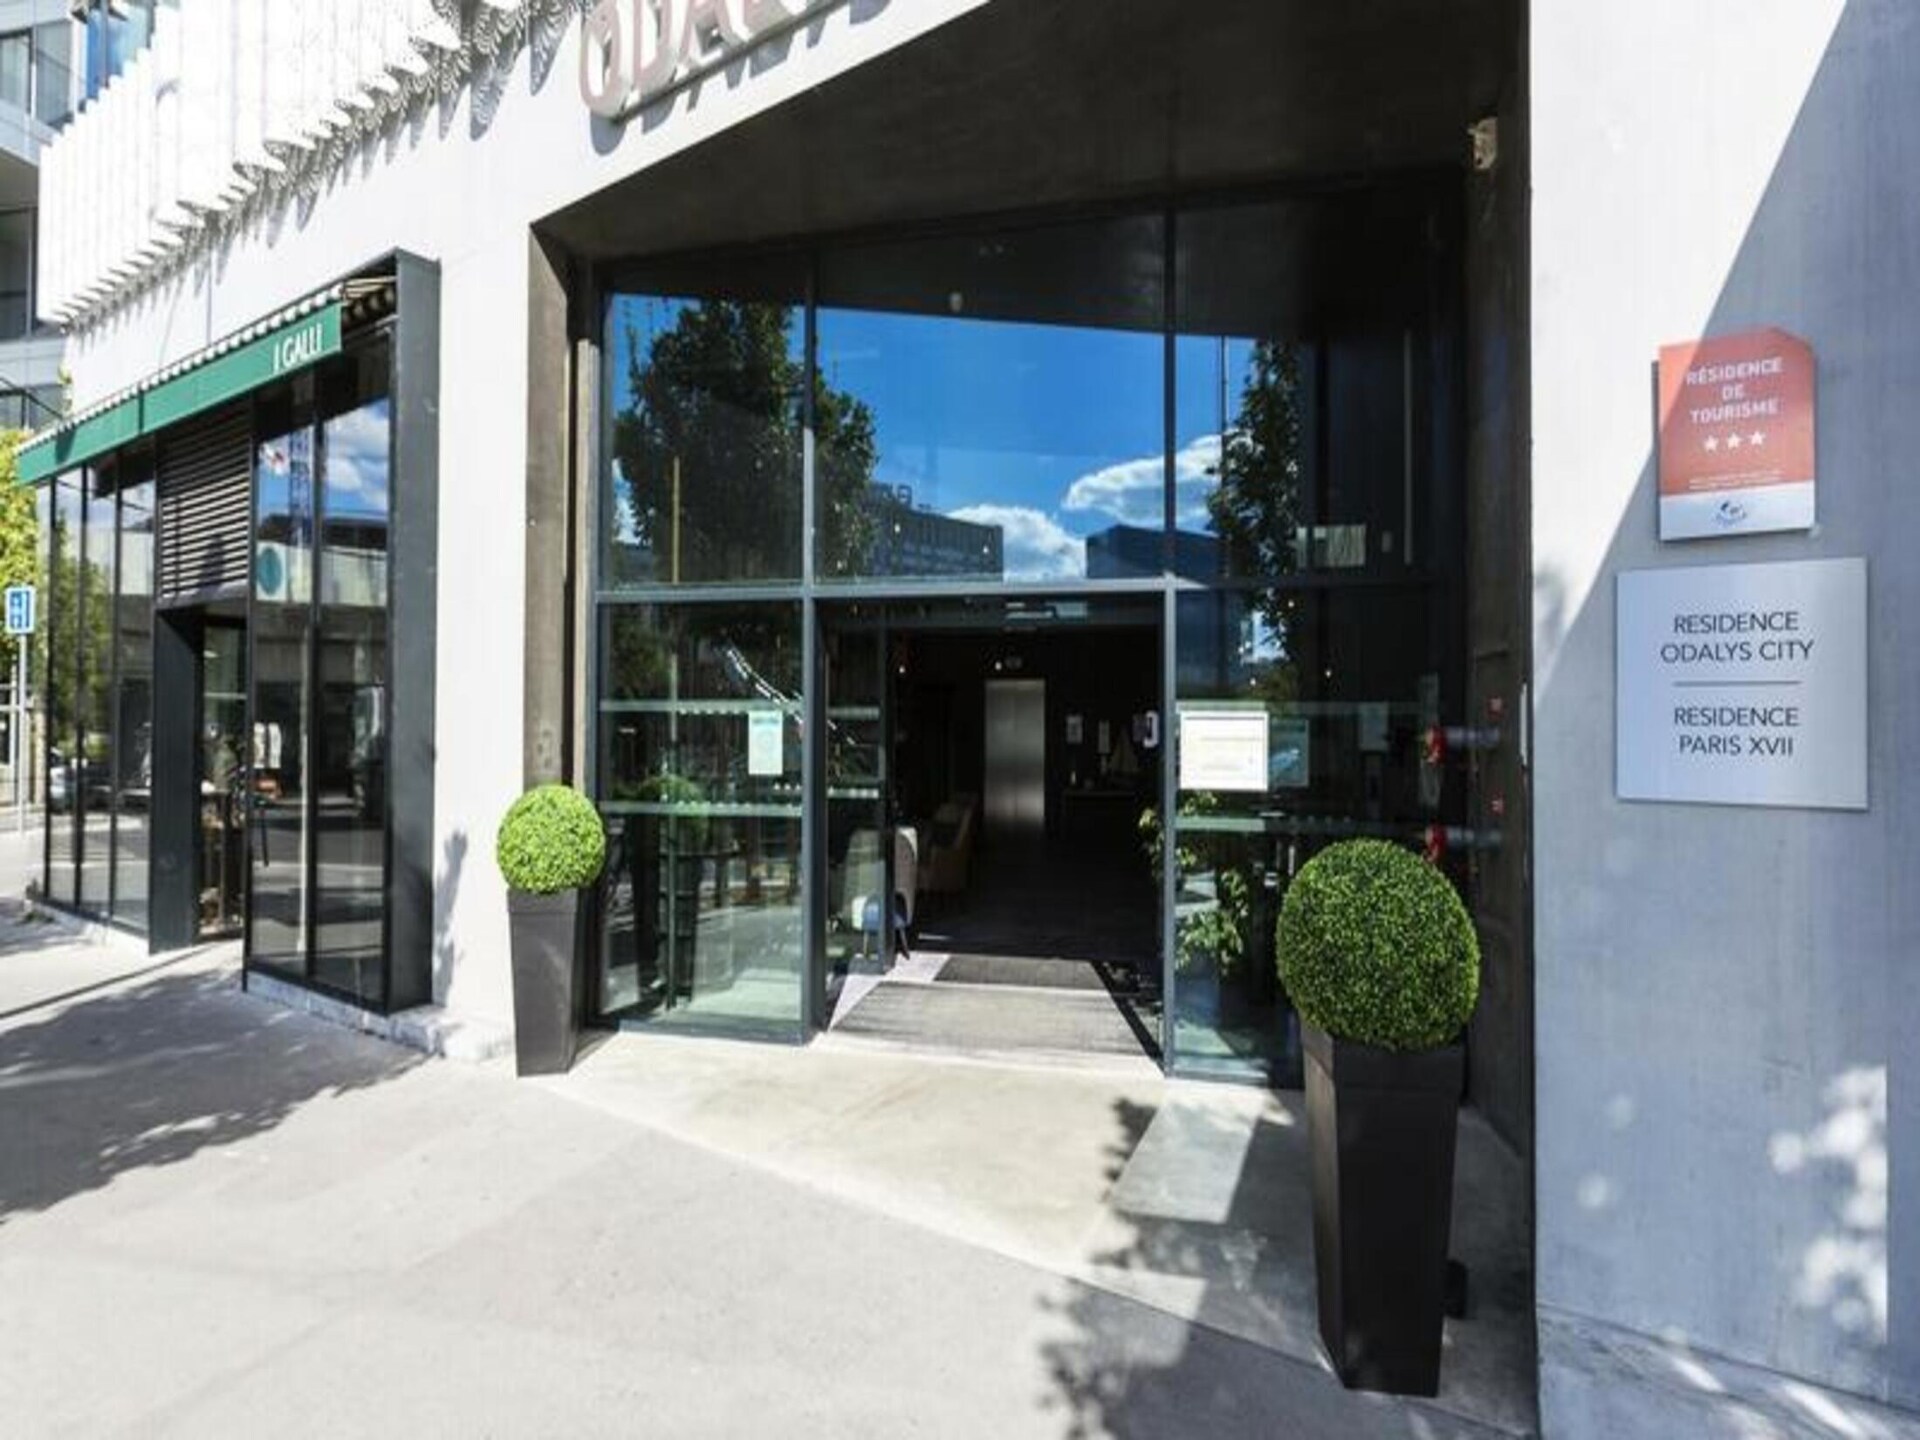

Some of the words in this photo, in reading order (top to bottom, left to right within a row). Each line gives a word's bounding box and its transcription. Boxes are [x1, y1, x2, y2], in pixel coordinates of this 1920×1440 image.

[1722, 384, 1744, 399] DE
[1690, 398, 1778, 424] TOURISME
[1673, 611, 1800, 635] RESIDENCE
[1660, 641, 1753, 664] ODALYS
[1758, 638, 1815, 662] CITY
[1673, 706, 1800, 728] RESIDENCE
[1679, 735, 1742, 756] PARIS
[1748, 736, 1794, 758] XVII
